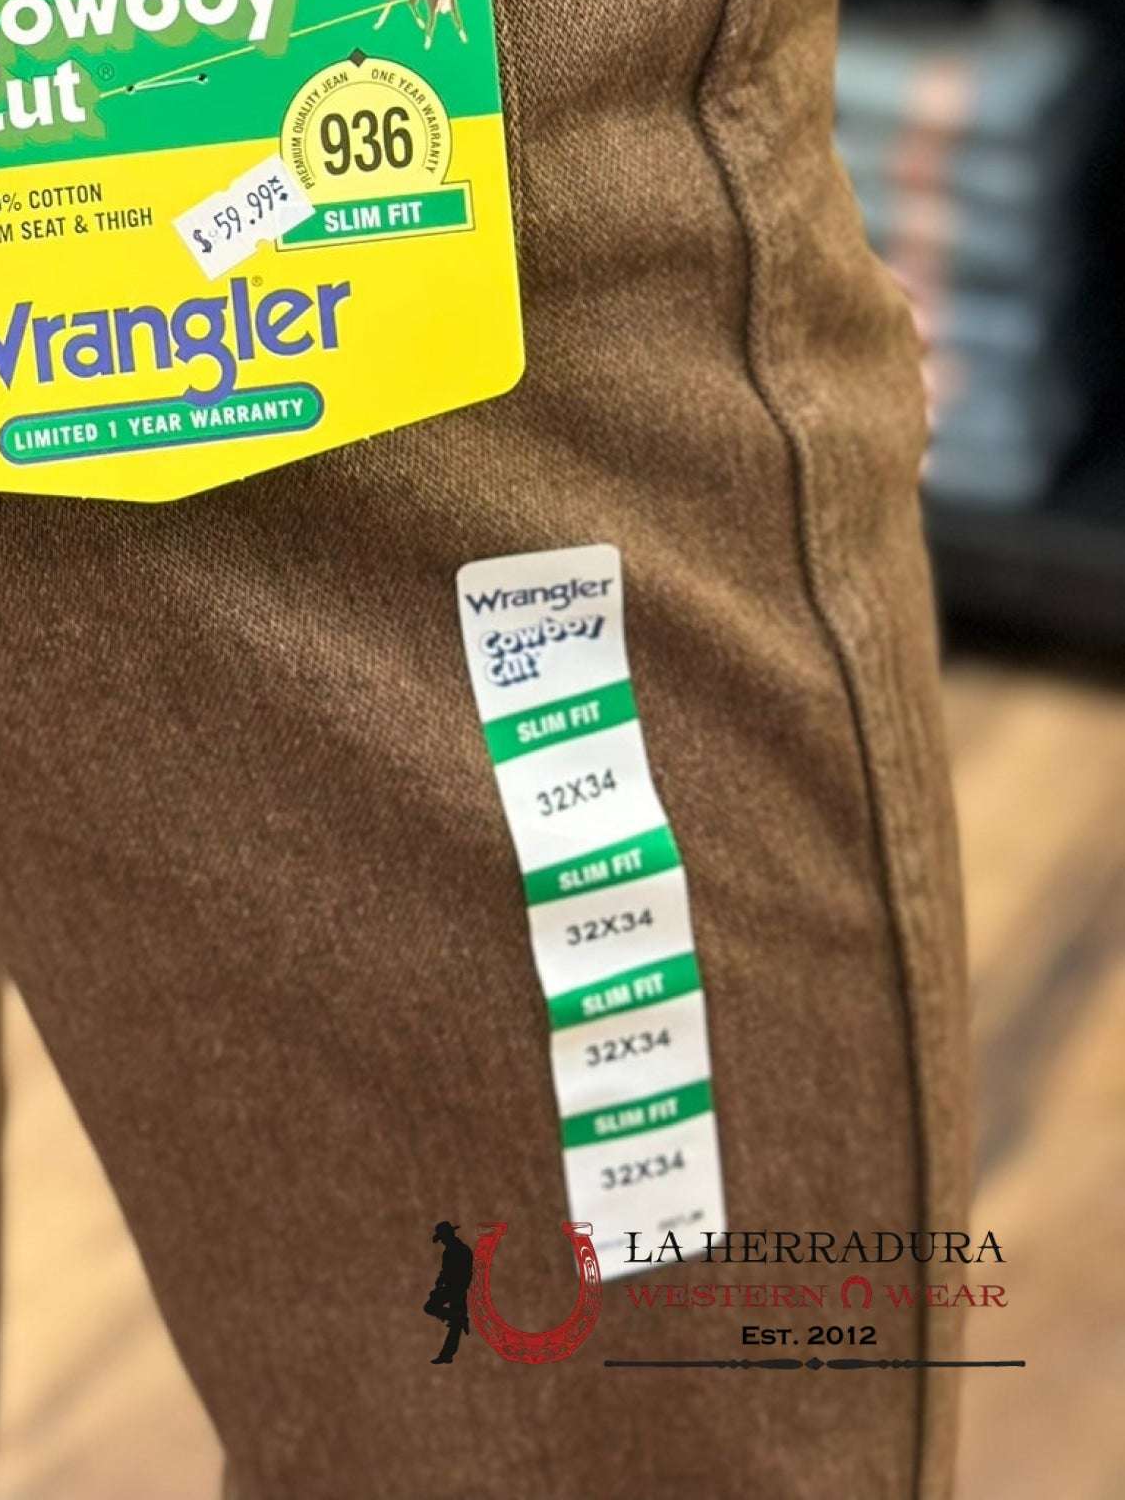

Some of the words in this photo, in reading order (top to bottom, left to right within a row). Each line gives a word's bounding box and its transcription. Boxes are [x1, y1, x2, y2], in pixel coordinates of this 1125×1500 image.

[322, 71, 349, 94] JEAN
[292, 90, 322, 134] QUALITY
[371, 68, 395, 84] ONE
[398, 76, 427, 104] YEAR
[421, 103, 442, 175] WARRANTY
[320, 106, 414, 176] 936
[290, 138, 316, 190] PREMIUM
[28, 182, 103, 209] COTTON
[21, 216, 67, 241] SEAT
[74, 214, 89, 235] &
[94, 207, 153, 232] THIGH
[323, 205, 381, 233] SLIM
[387, 201, 423, 227] FIT
[13, 423, 98, 451] LIMITED
[108, 420, 118, 439] 1
[128, 414, 182, 436] YEAR
[189, 398, 304, 430] WARRANTY
[465, 577, 615, 615] Wrangler
[481, 615, 606, 658] Cowboy
[486, 653, 541, 687] Cut
[516, 711, 567, 743] SLIM
[570, 700, 602, 726] FIT
[536, 768, 617, 817] 32X34
[558, 860, 610, 891] SLIM
[611, 848, 643, 876] FIT
[565, 907, 654, 946] 32X34
[581, 984, 632, 1016] SLIM
[632, 972, 664, 1000] FIT
[585, 1029, 672, 1068] 32X34
[593, 1108, 646, 1136] SLIM
[648, 1097, 678, 1123] FIT
[600, 1151, 686, 1190] 32X34
